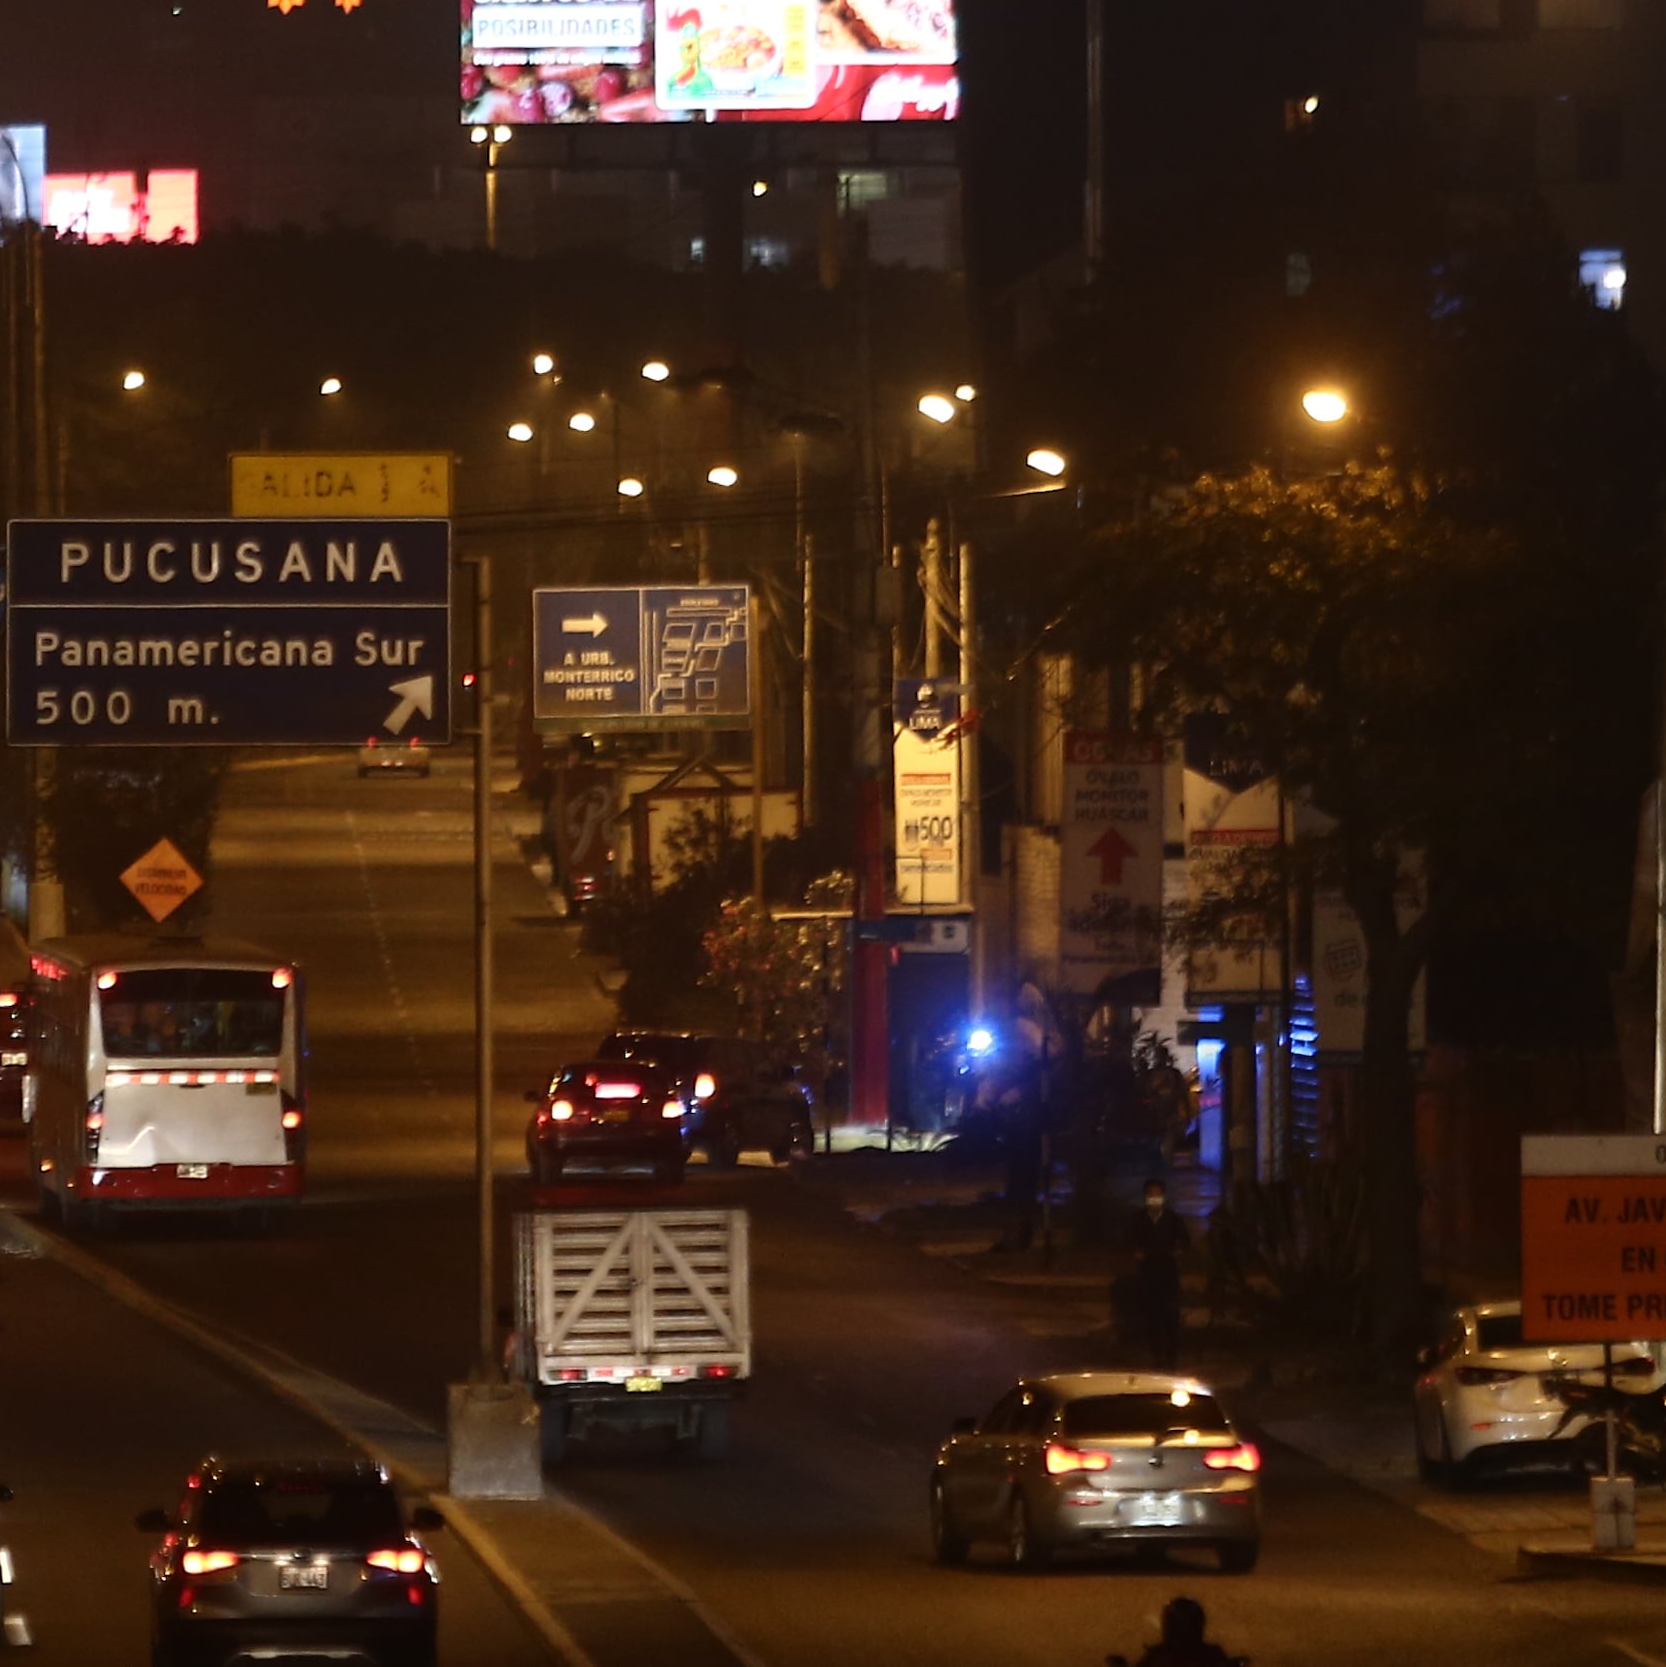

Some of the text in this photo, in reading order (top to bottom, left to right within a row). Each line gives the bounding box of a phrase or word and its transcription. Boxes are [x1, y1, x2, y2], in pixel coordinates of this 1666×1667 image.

[478, 17, 635, 37] POSIBILIDADES
[61, 541, 404, 585] PUCUSANA
[36, 629, 425, 668] Panamericana Sur
[564, 651, 574, 665] A
[543, 669, 636, 684] MONTERRICO
[565, 686, 614, 702] NORTE
[36, 690, 220, 726] 500 m.
[1564, 1197, 1608, 1224] AV.
[1620, 1247, 1657, 1274] EN
[1542, 1293, 1618, 1322] TOME
